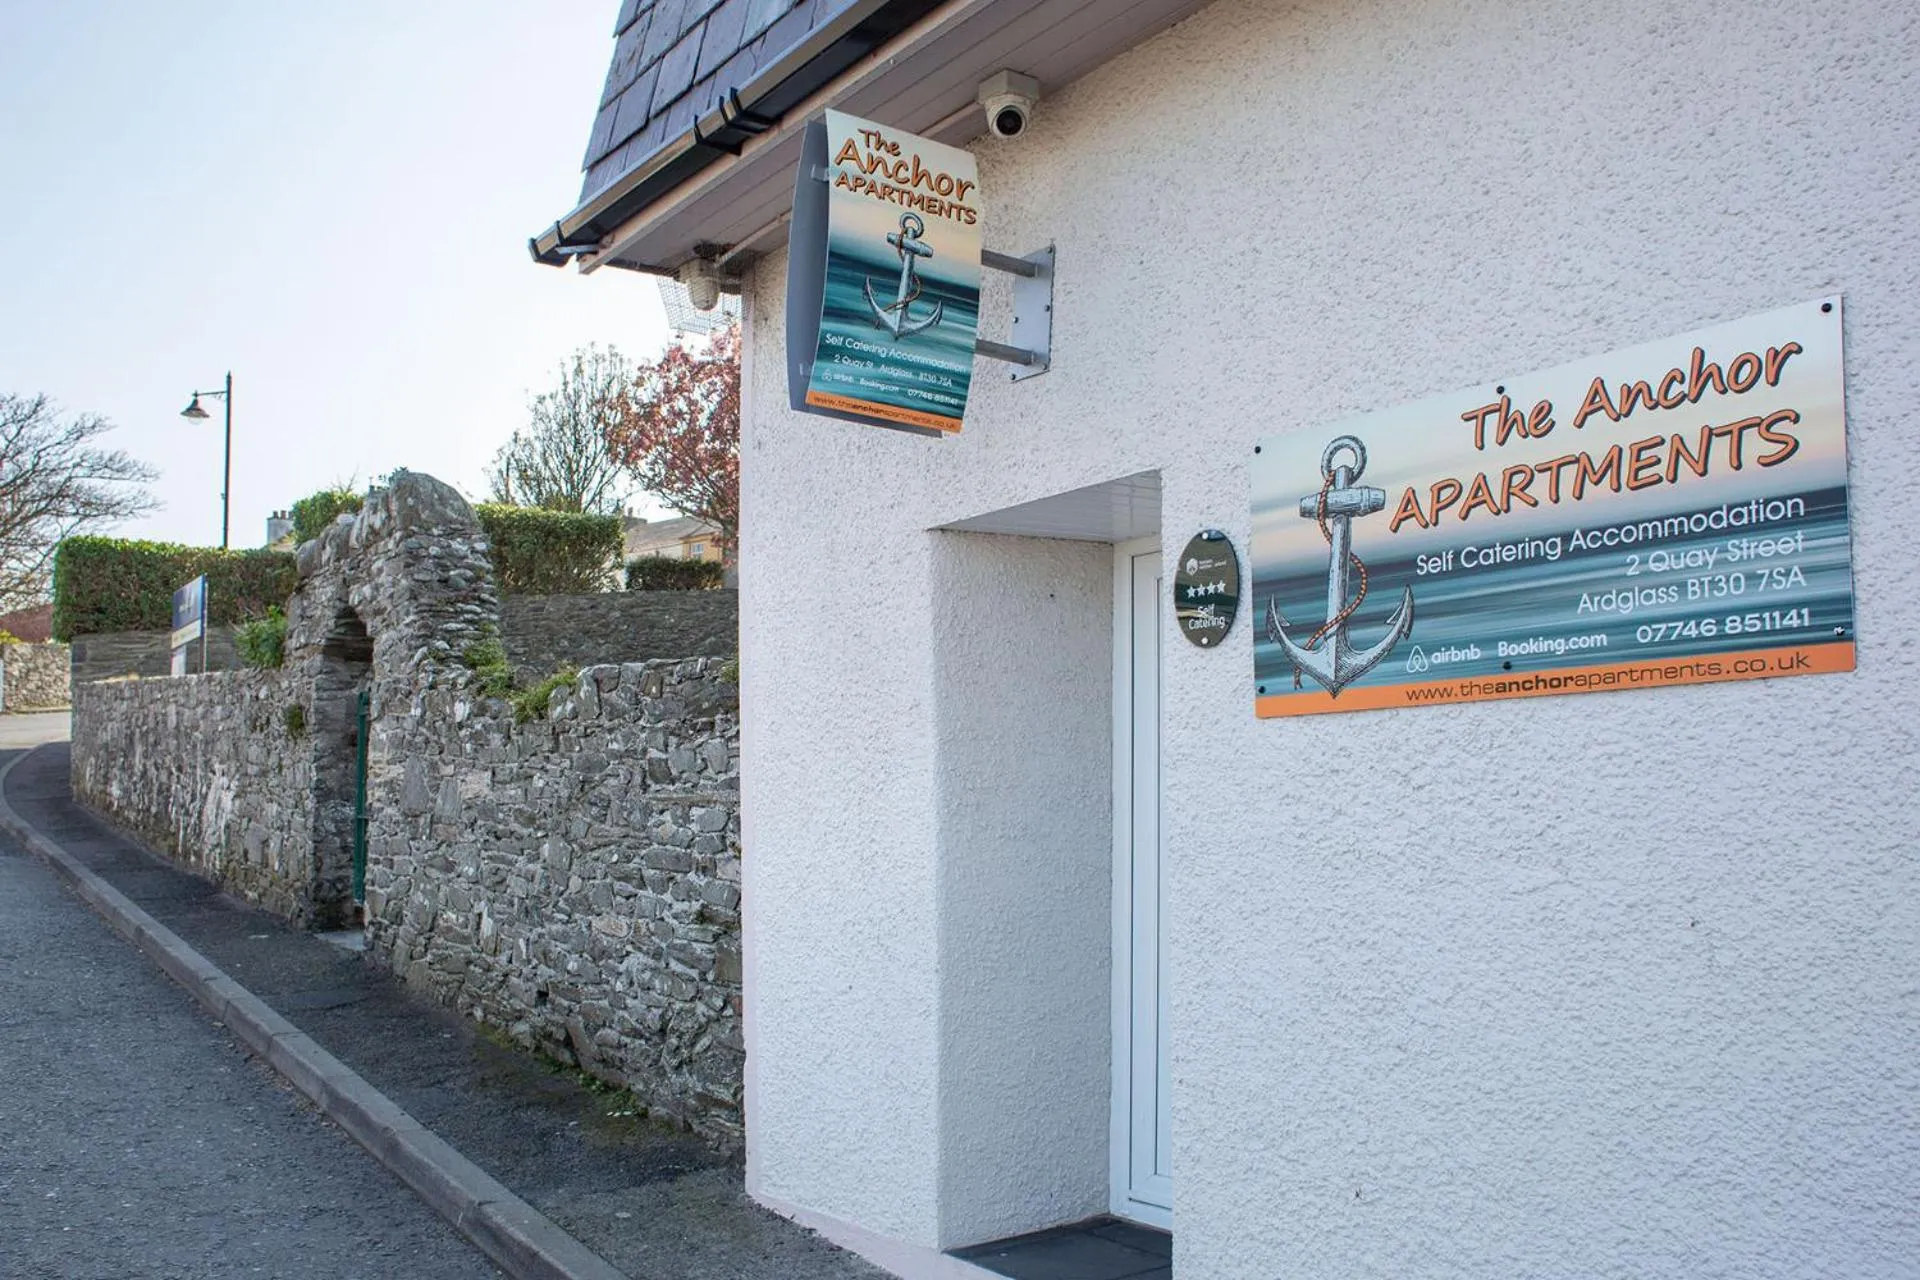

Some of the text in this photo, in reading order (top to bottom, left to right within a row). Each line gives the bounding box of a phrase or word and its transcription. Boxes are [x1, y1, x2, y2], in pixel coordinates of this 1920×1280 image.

[858, 128, 901, 156] The
[834, 138, 975, 201] Anchor
[835, 171, 977, 225] APARTMENTS
[825, 333, 966, 371] Self Catering Accommodation
[833, 354, 841, 363] 2
[842, 356, 865, 369] Quay
[879, 364, 913, 378] Ardglass
[859, 378, 899, 391] Booking.com
[1462, 341, 1803, 451] The Anchor
[1388, 409, 1800, 534] APARTMENTS
[1416, 497, 1805, 576] Self Catering Accommodation
[1626, 530, 1805, 577] 2 Quay Street
[1577, 565, 1807, 615] Ardglass BT30 7SA
[1189, 616, 1226, 630] Catering
[1431, 607, 1811, 664] airbnb Booking.com 07746 851141
[1406, 652, 1811, 700] www.theanchorapartments.co.uk
